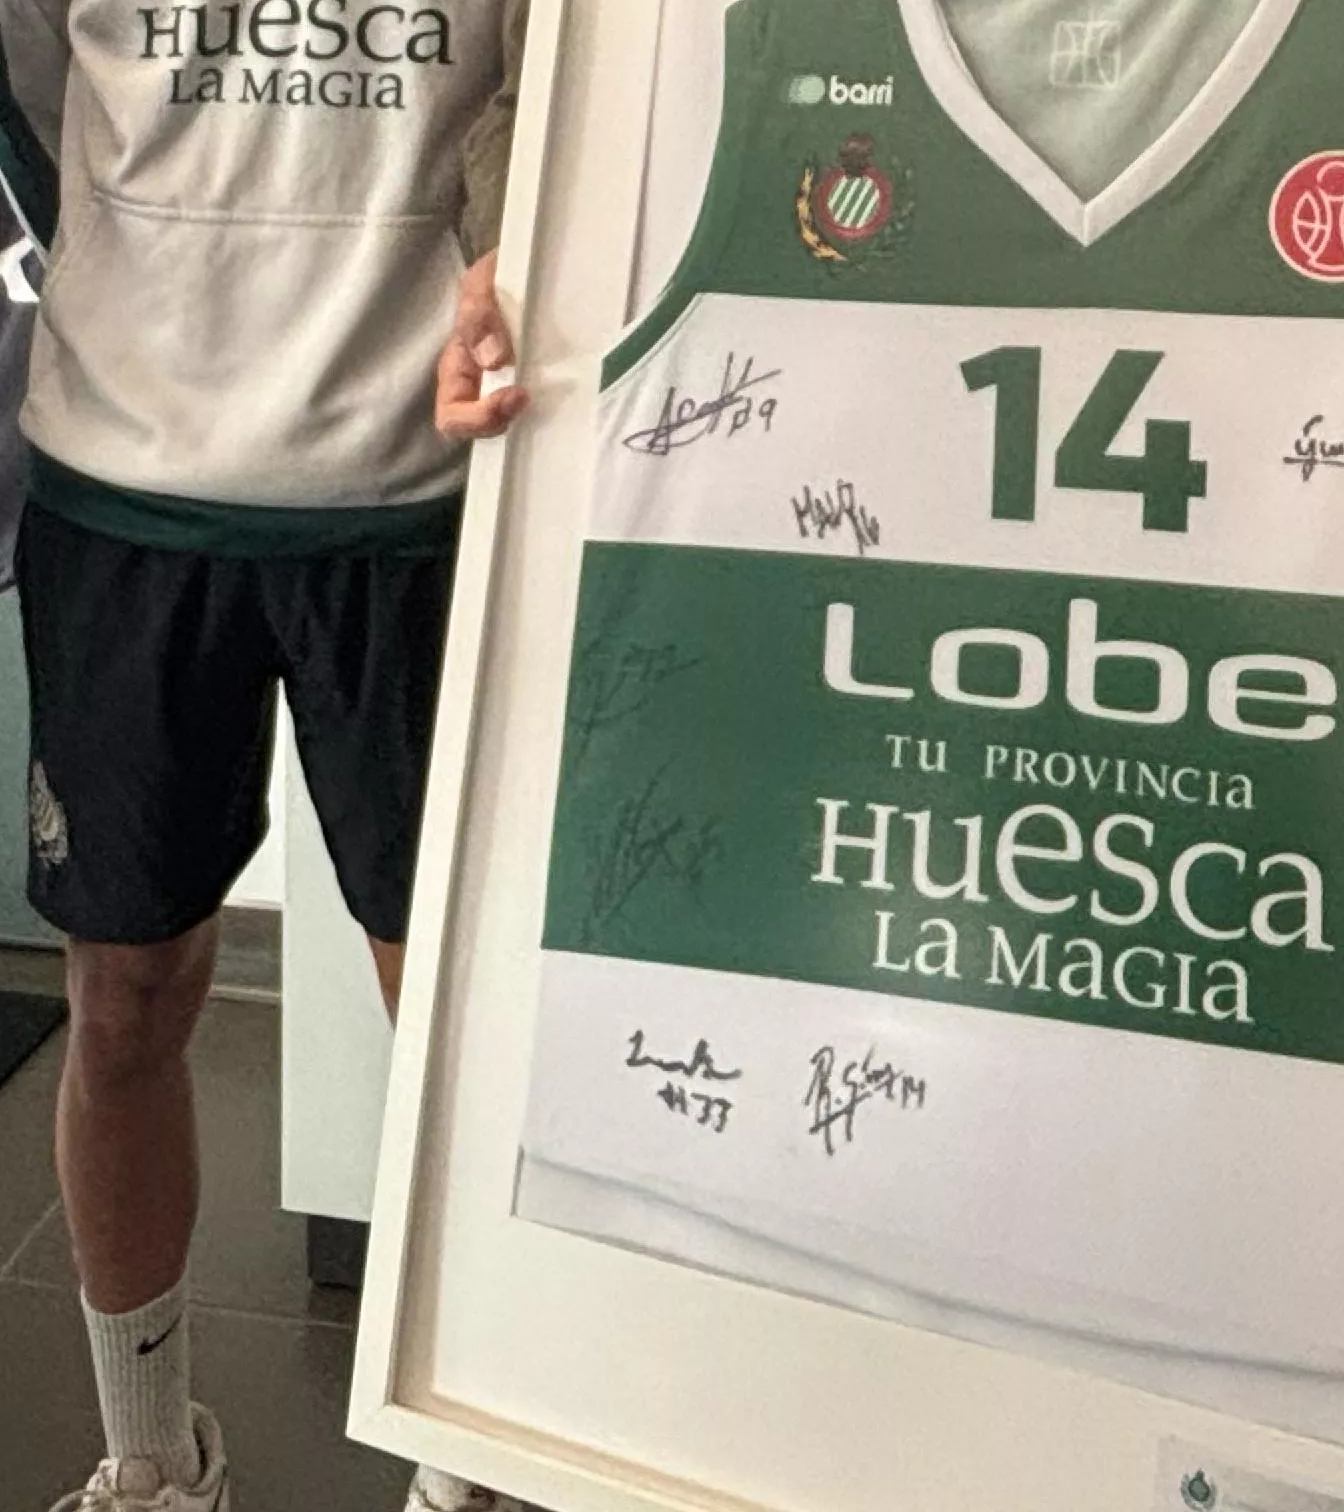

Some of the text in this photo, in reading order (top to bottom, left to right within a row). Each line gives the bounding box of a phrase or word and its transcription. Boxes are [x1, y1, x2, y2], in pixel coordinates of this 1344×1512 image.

[957, 344, 1208, 535] 14
[823, 597, 1339, 743] Lobe
[810, 797, 1337, 954] Huesca
